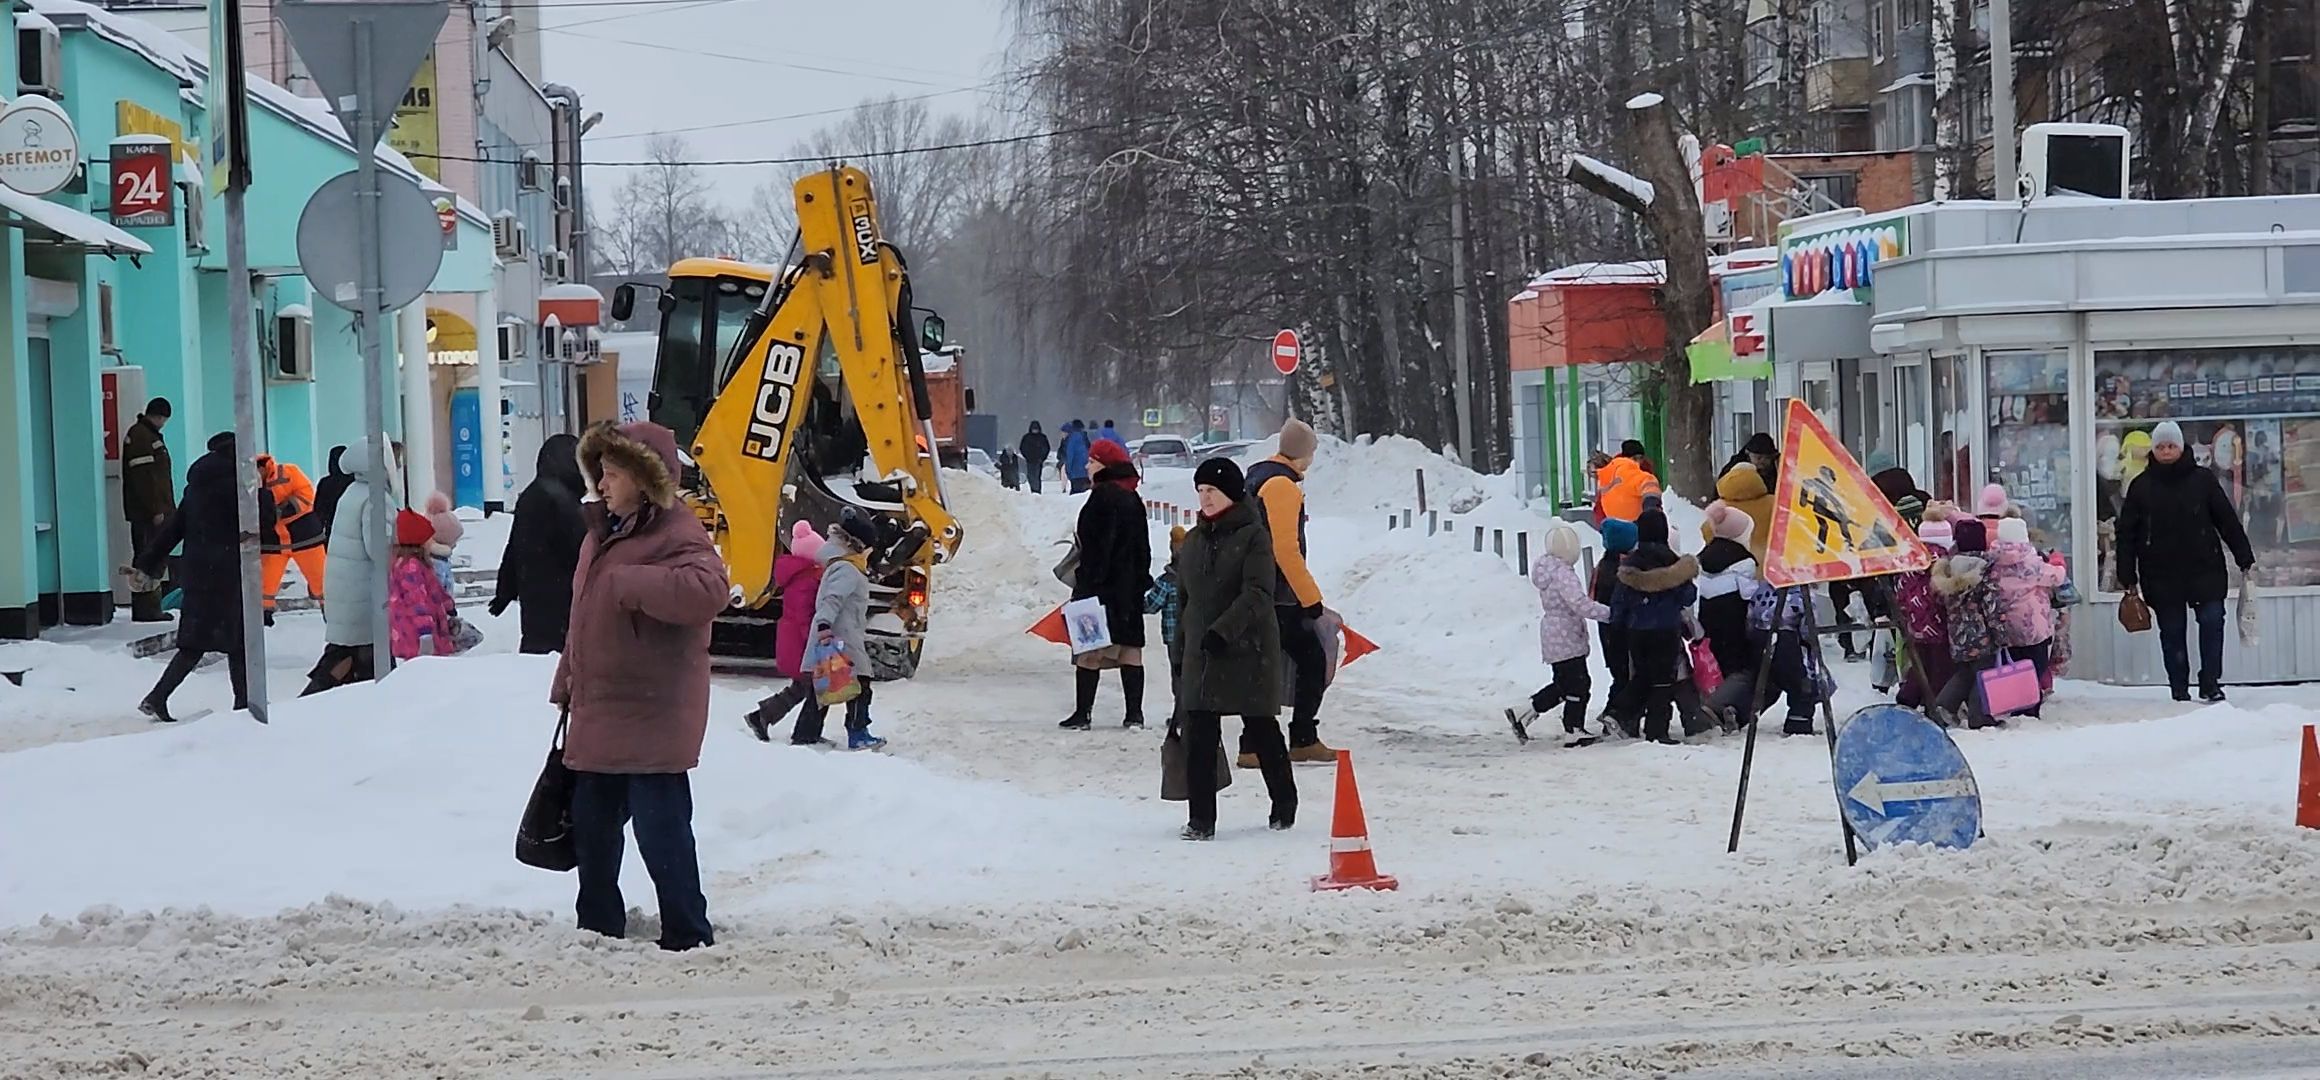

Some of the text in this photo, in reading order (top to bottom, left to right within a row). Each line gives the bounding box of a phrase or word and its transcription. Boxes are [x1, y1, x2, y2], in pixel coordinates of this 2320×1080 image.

[126, 145, 156, 154] КАФЕ
[118, 166, 164, 205] 24
[855, 216, 878, 258] 3CX
[750, 344, 802, 459] JCB
